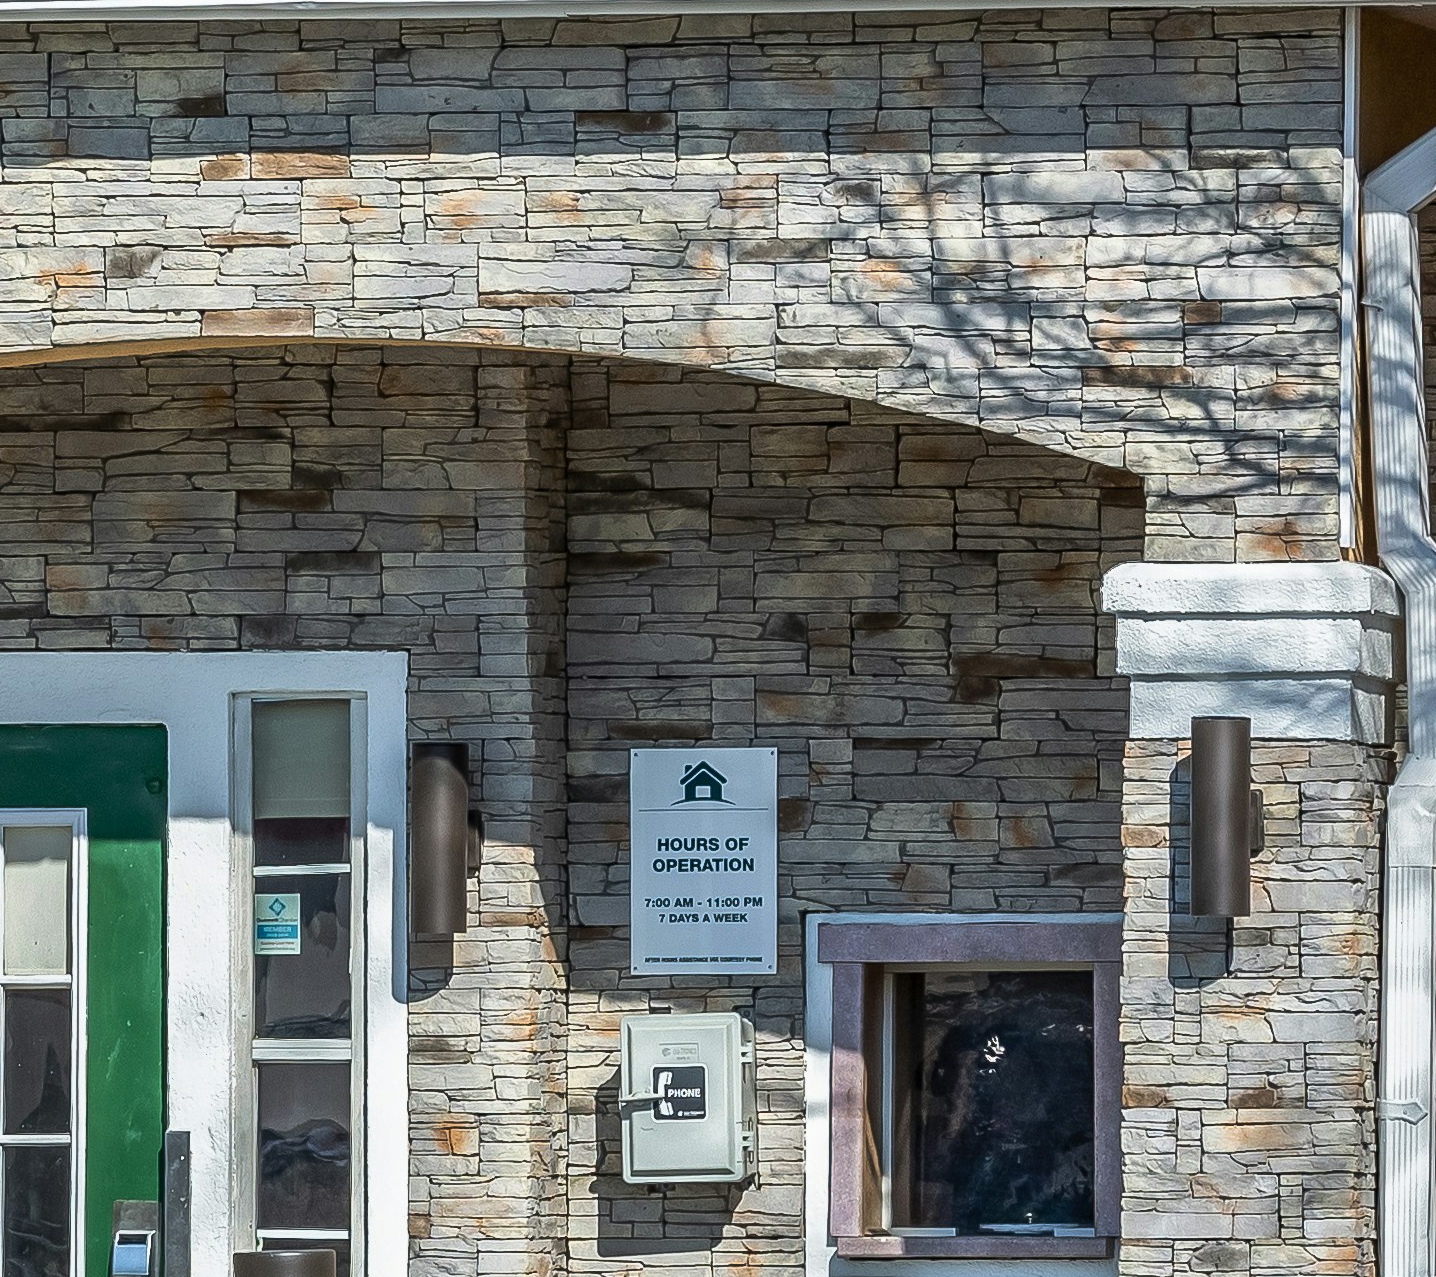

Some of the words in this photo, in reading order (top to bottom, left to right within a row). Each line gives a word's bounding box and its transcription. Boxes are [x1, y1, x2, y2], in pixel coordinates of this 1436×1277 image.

[657, 837, 720, 852] HOURS
[725, 837, 750, 852] OF
[652, 857, 755, 873] OPERATION
[644, 897, 671, 908] 7:00
[674, 897, 694, 908] AM
[706, 897, 740, 908] 11:00
[743, 896, 763, 907] PM
[658, 913, 666, 923] 7
[669, 913, 699, 923] DAYS
[702, 913, 711, 923] A
[713, 913, 748, 923] WEEK
[667, 1088, 701, 1098] PHONE
